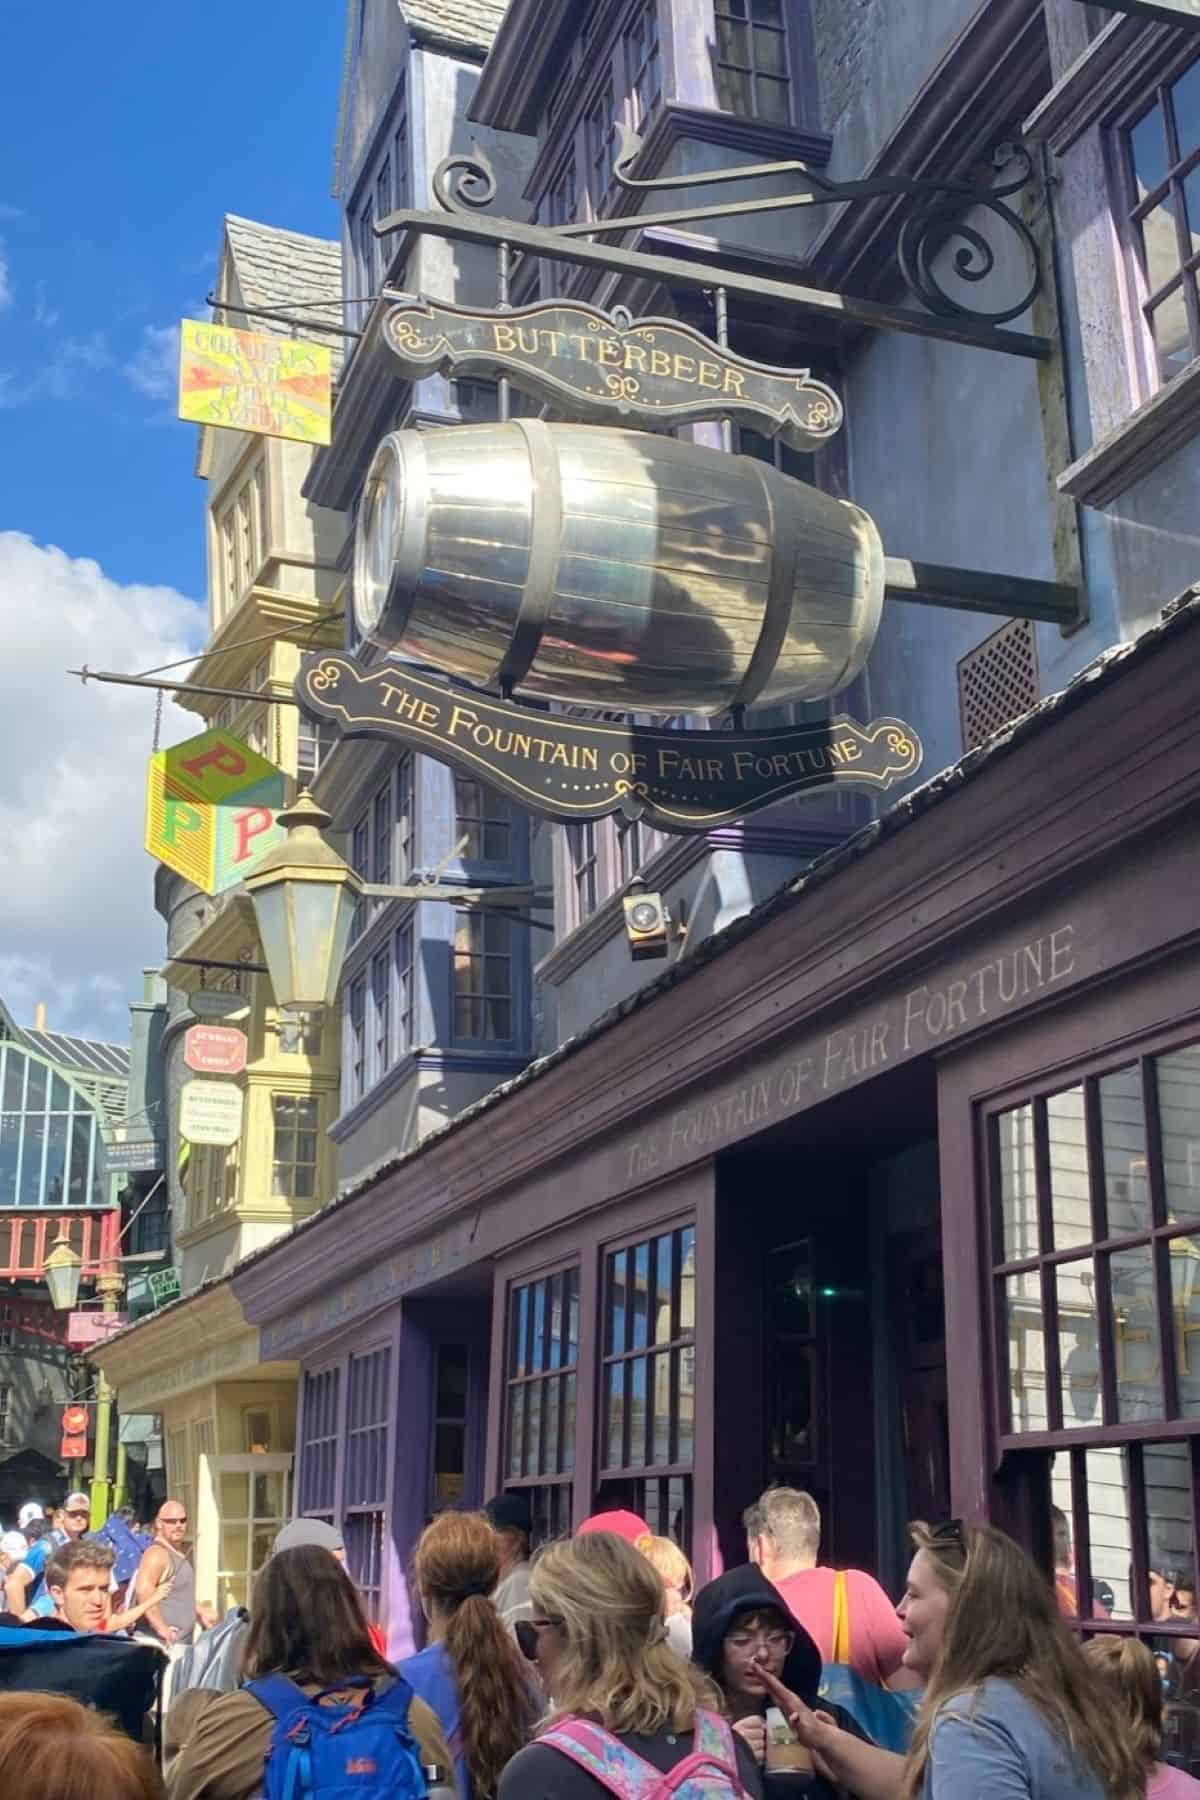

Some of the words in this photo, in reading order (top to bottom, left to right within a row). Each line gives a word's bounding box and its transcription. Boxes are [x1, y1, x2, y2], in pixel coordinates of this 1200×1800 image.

[493, 324, 747, 396] BUTTERBEER
[180, 741, 246, 779] P
[379, 682, 441, 728] THE
[448, 706, 600, 771] FOUNTAIN
[610, 752, 646, 775] OF
[657, 749, 723, 780] FAIR
[732, 738, 863, 781] FORTUNE
[160, 790, 202, 848] P
[231, 806, 273, 863] P
[669, 1078, 769, 1156] FOUNTAIN
[778, 1056, 813, 1107] OF
[822, 1021, 890, 1089] FAIR
[902, 924, 1076, 1051] FORTUNE
